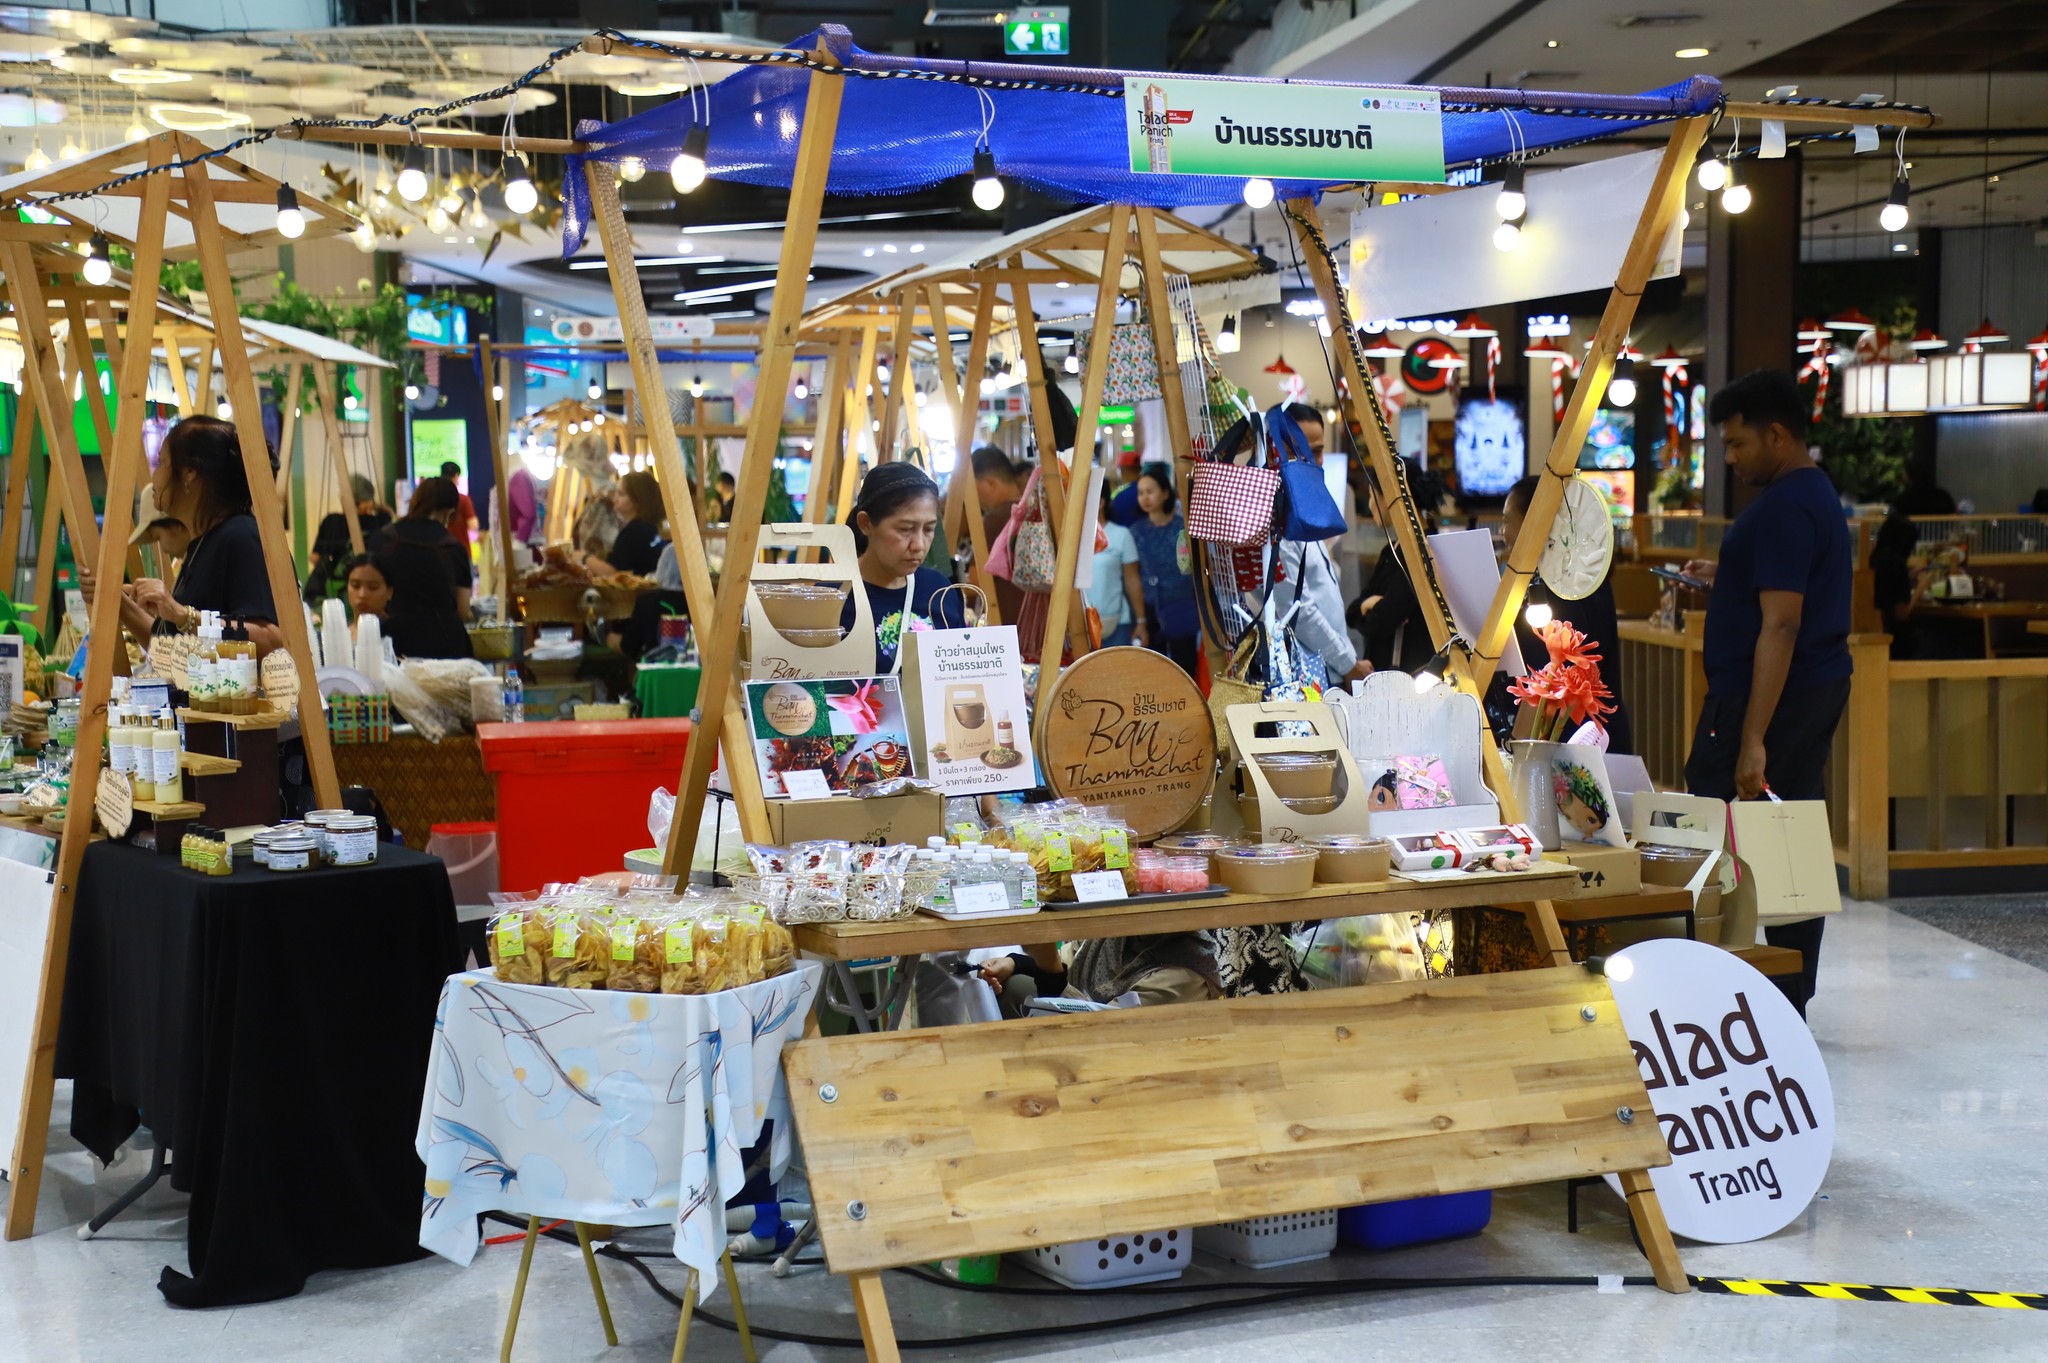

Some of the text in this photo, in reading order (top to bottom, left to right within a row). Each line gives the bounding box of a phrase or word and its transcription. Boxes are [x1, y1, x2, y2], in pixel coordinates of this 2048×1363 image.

[1138, 110, 1168, 125] Talad
[1140, 125, 1173, 138] Panich
[1214, 116, 1373, 150] บ้านธรรมชาติ
[934, 642, 1005, 659] ข้าวยำสมุนไพร
[1133, 693, 1155, 706] บ้าน
[1133, 698, 1186, 716] ธรรมชาติ
[1082, 699, 1172, 767] Ban
[1065, 740, 1204, 788] Thammachat
[945, 773, 1008, 787] ราคาเพียง 250.-
[1082, 787, 1146, 802] YANTAKHAO
[1157, 781, 1191, 792] TRANG
[1629, 992, 1769, 1090] alad
[1657, 1065, 1819, 1156] anich
[1689, 1157, 1783, 1204] Trang
